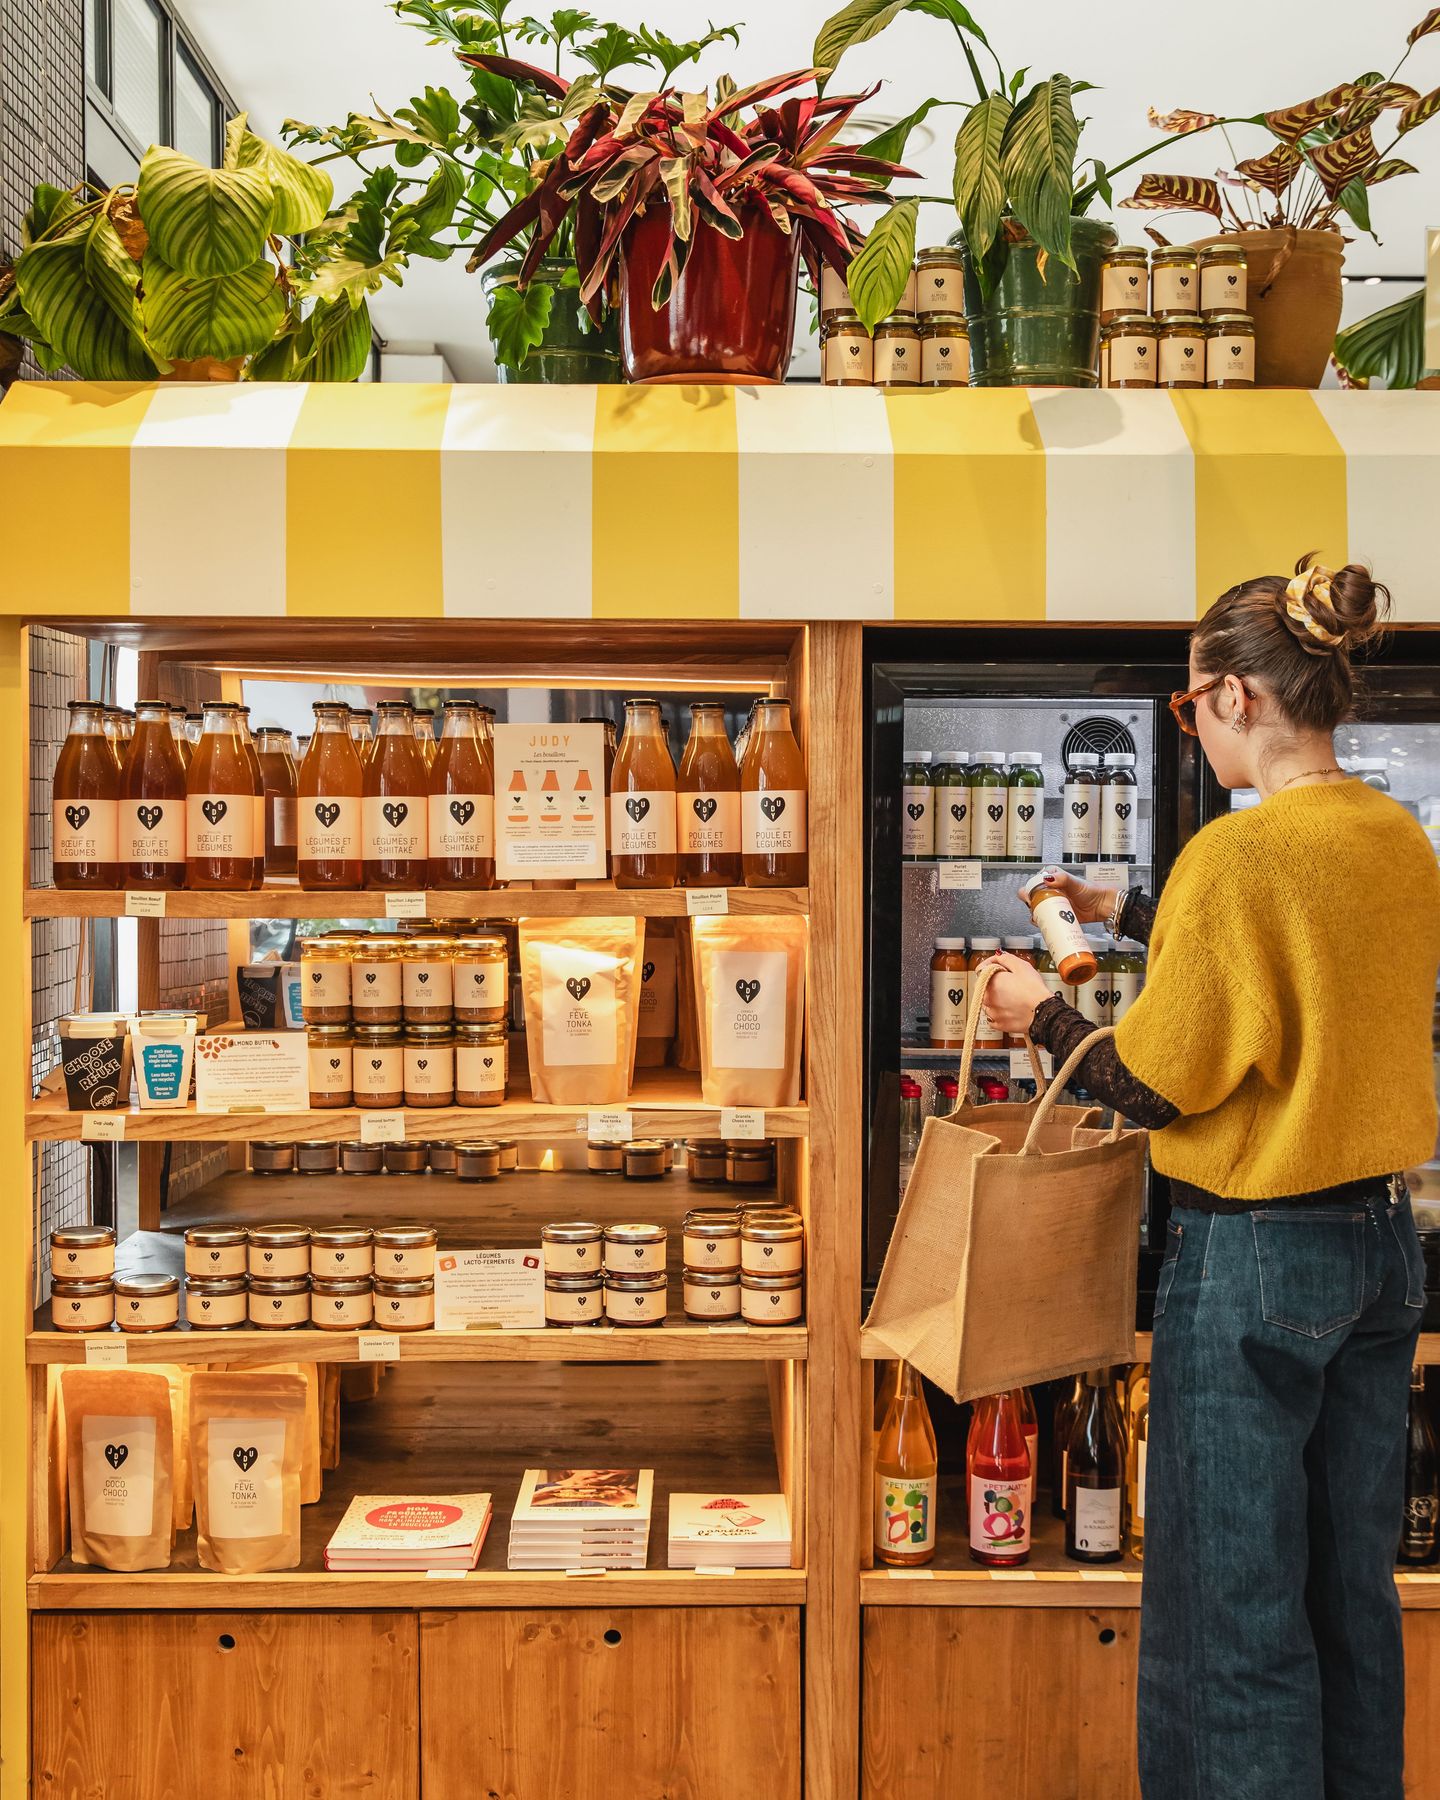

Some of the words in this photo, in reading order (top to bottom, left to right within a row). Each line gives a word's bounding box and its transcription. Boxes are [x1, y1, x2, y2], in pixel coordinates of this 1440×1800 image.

[529, 735, 571, 747] JUDY
[197, 835, 221, 843] BŒUF
[621, 832, 645, 840] POULE
[647, 832, 656, 840] ET
[688, 832, 712, 840] POULE
[714, 831, 723, 839] ET
[755, 831, 780, 839] POULE
[782, 831, 791, 839] ET
[61, 840, 84, 848] BŒUF
[86, 840, 96, 848] ET
[133, 840, 156, 848] BŒUF
[160, 840, 168, 848] ET
[736, 1013, 758, 1021] COCO
[566, 1020, 592, 1028] TONKA
[733, 1022, 761, 1031] CHOCO
[64, 1038, 114, 1075] CHOOSE
[84, 1058, 103, 1075] TO
[78, 1058, 121, 1091] RE-USE
[463, 1258, 515, 1266] LACTO-FERMENTÉS
[105, 1480, 125, 1488] COCO
[102, 1488, 128, 1497] CHOCO
[231, 1492, 257, 1500] TONKA
